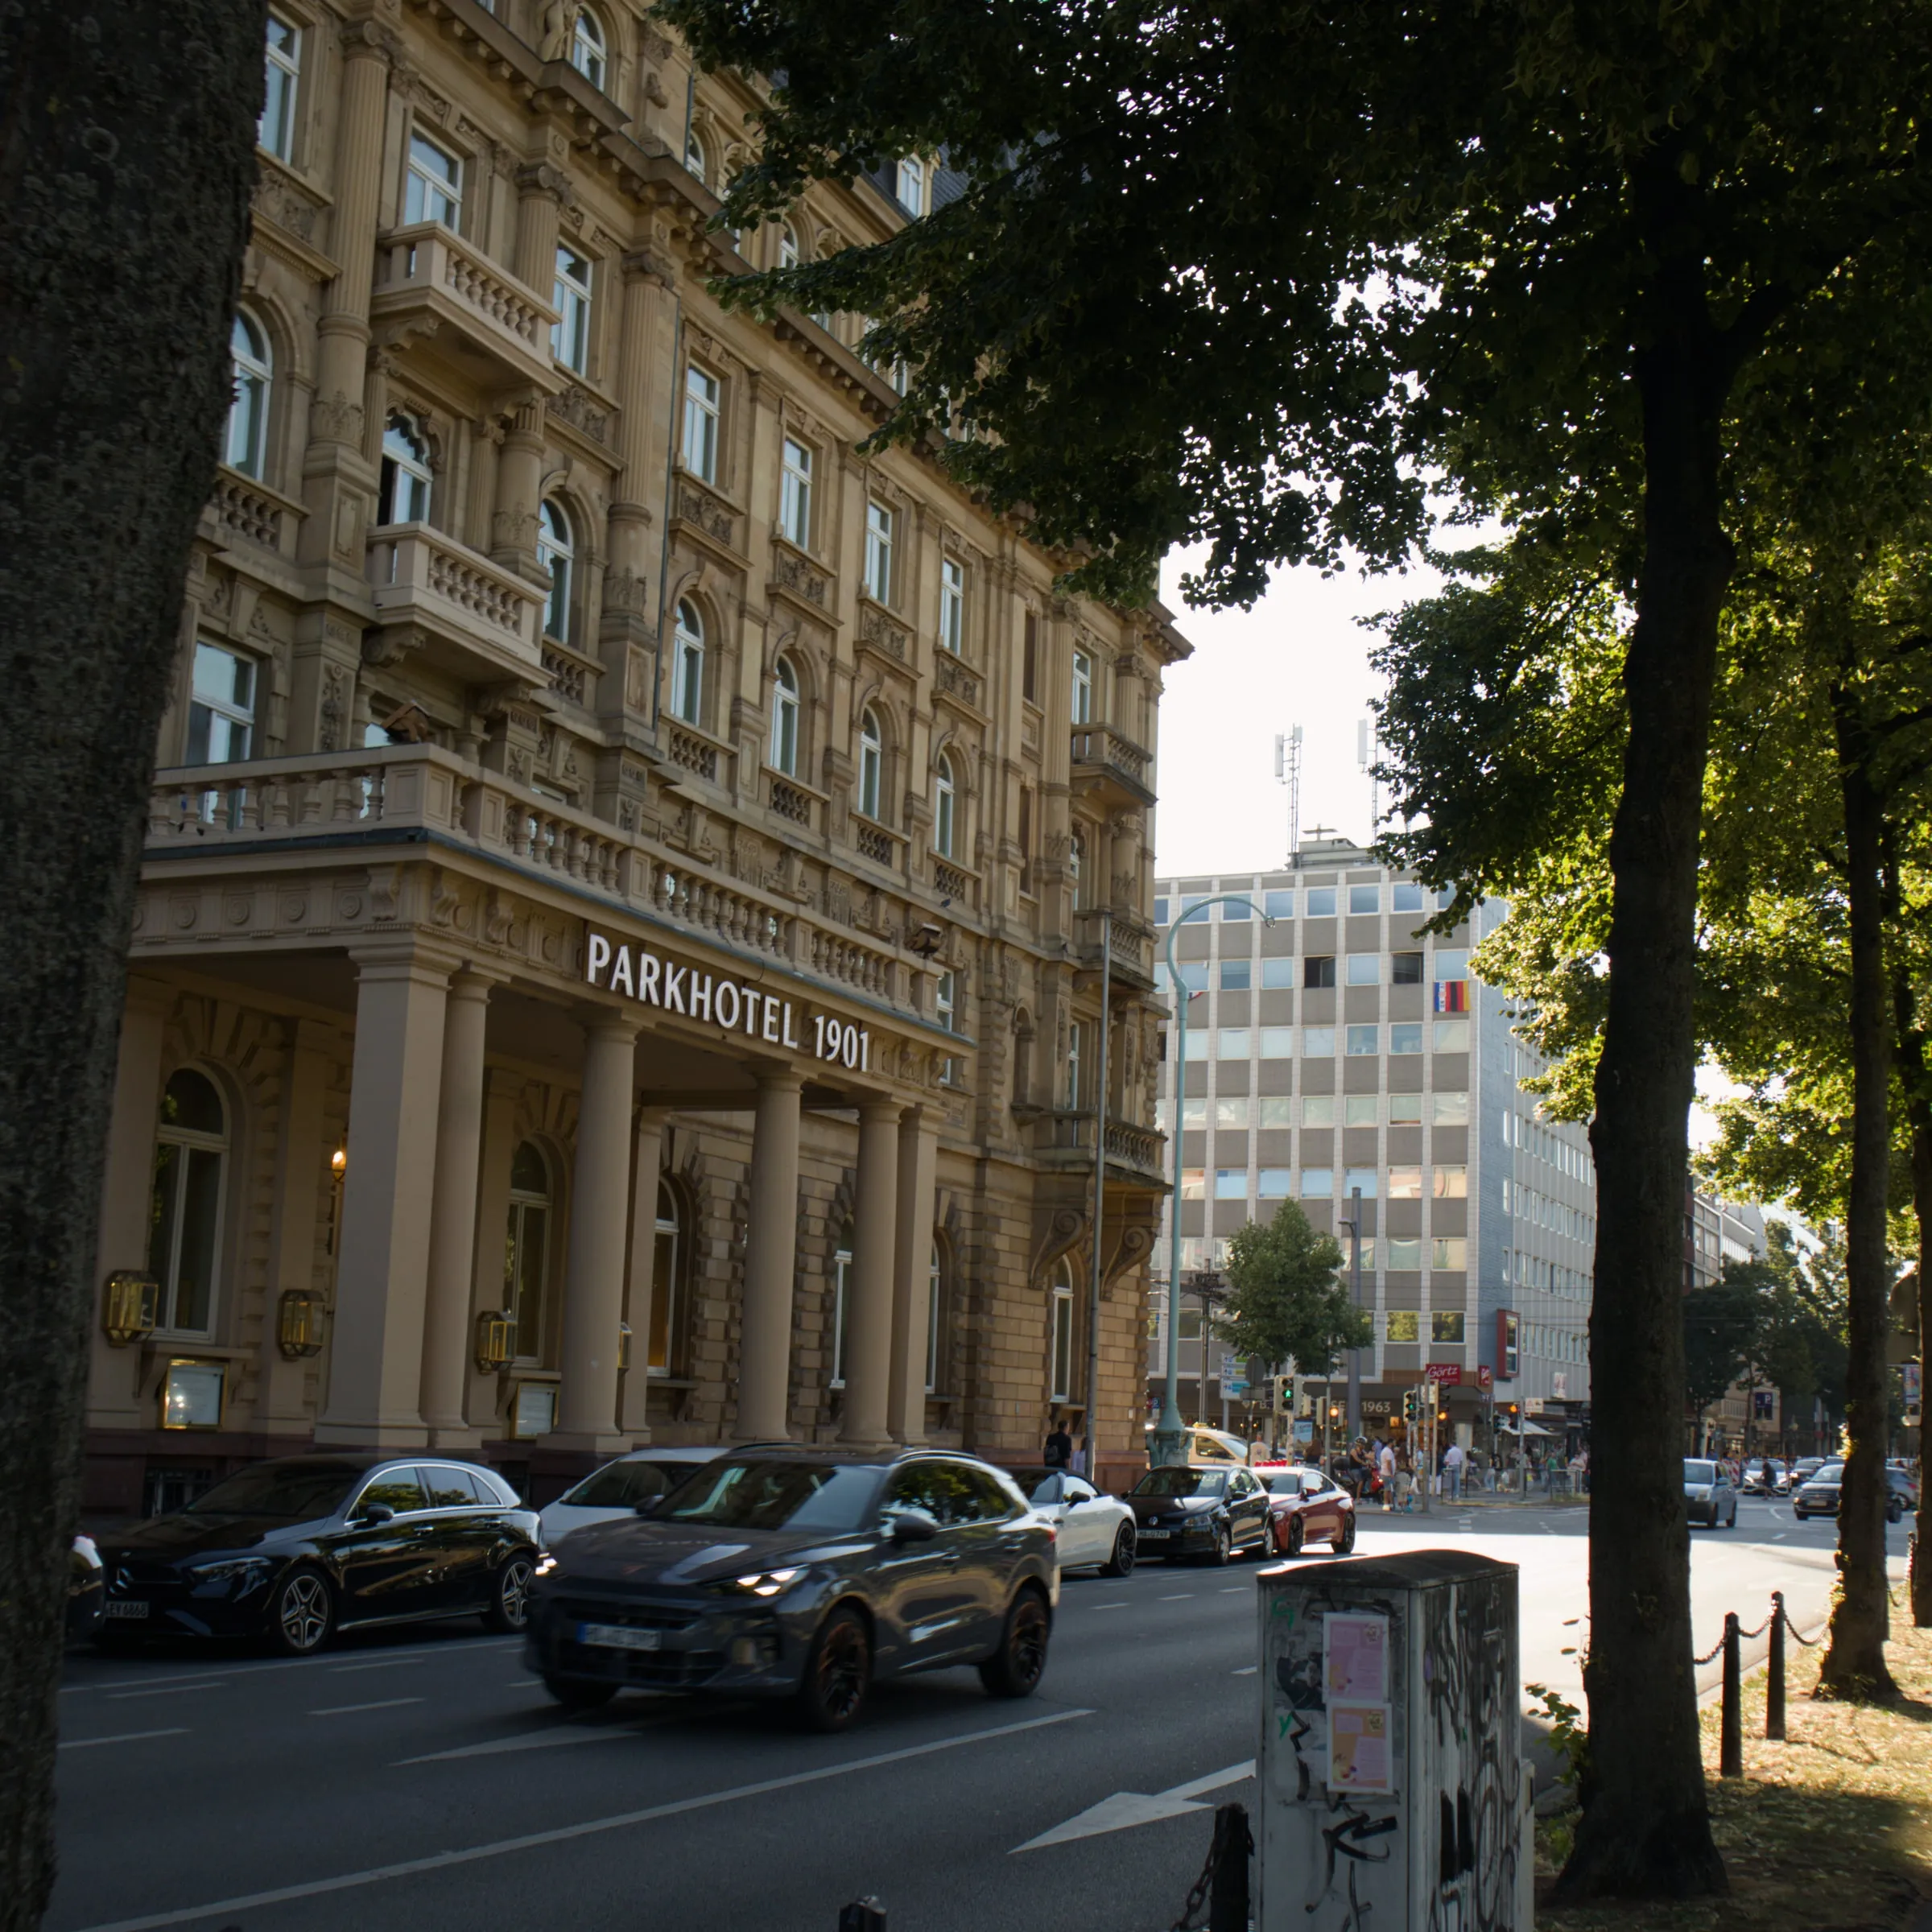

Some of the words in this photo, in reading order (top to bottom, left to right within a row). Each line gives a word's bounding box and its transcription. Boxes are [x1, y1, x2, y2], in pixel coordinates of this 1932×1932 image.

[588, 934, 798, 1049] PARKHOTEL
[815, 1015, 869, 1071] 1901
[1427, 1365, 1458, 1378] Görtz
[1361, 1401, 1391, 1413] 1963
